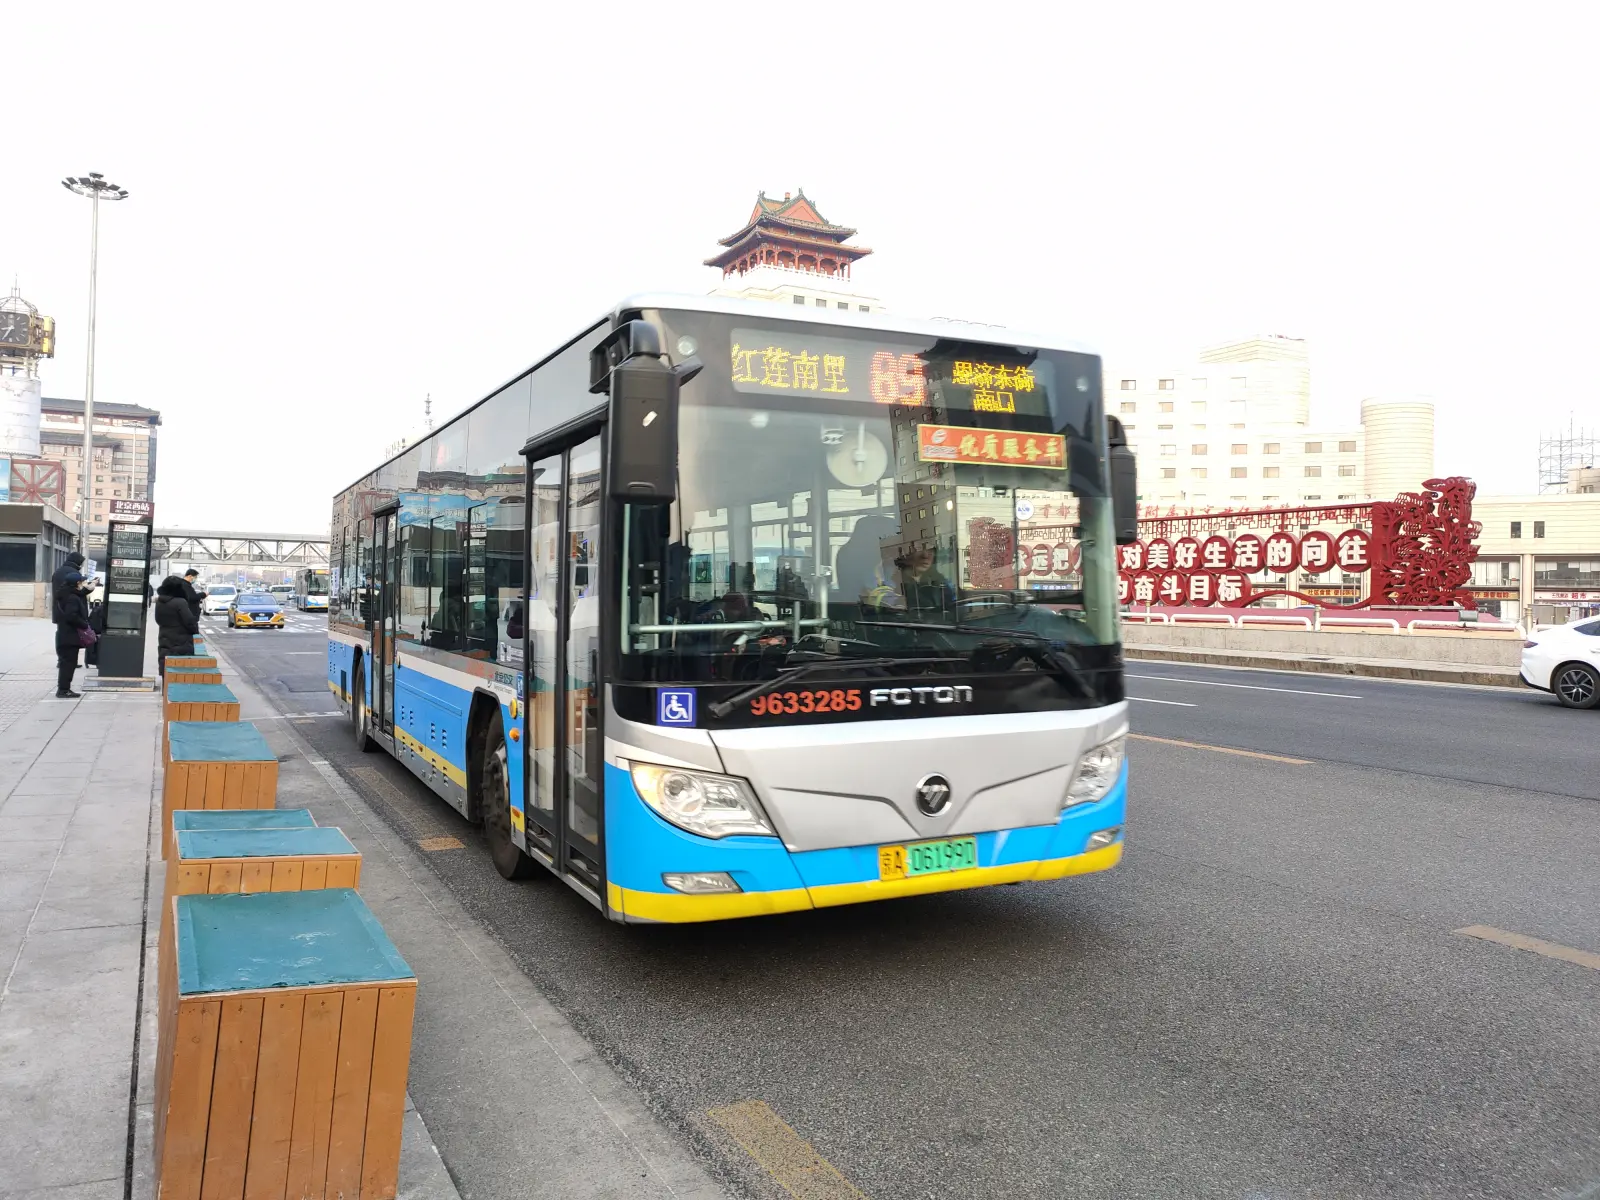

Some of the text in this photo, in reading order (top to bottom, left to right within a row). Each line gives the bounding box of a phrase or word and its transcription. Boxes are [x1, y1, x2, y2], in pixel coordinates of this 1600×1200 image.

[731, 343, 849, 393] 红莲南里
[952, 360, 1036, 393] 恩济东街
[973, 387, 1016, 413] 南口
[958, 433, 1061, 465] 优质服务车
[115, 500, 150, 511] 北京西站
[751, 690, 862, 716] 9633285
[870, 685, 973, 707] FOTON
